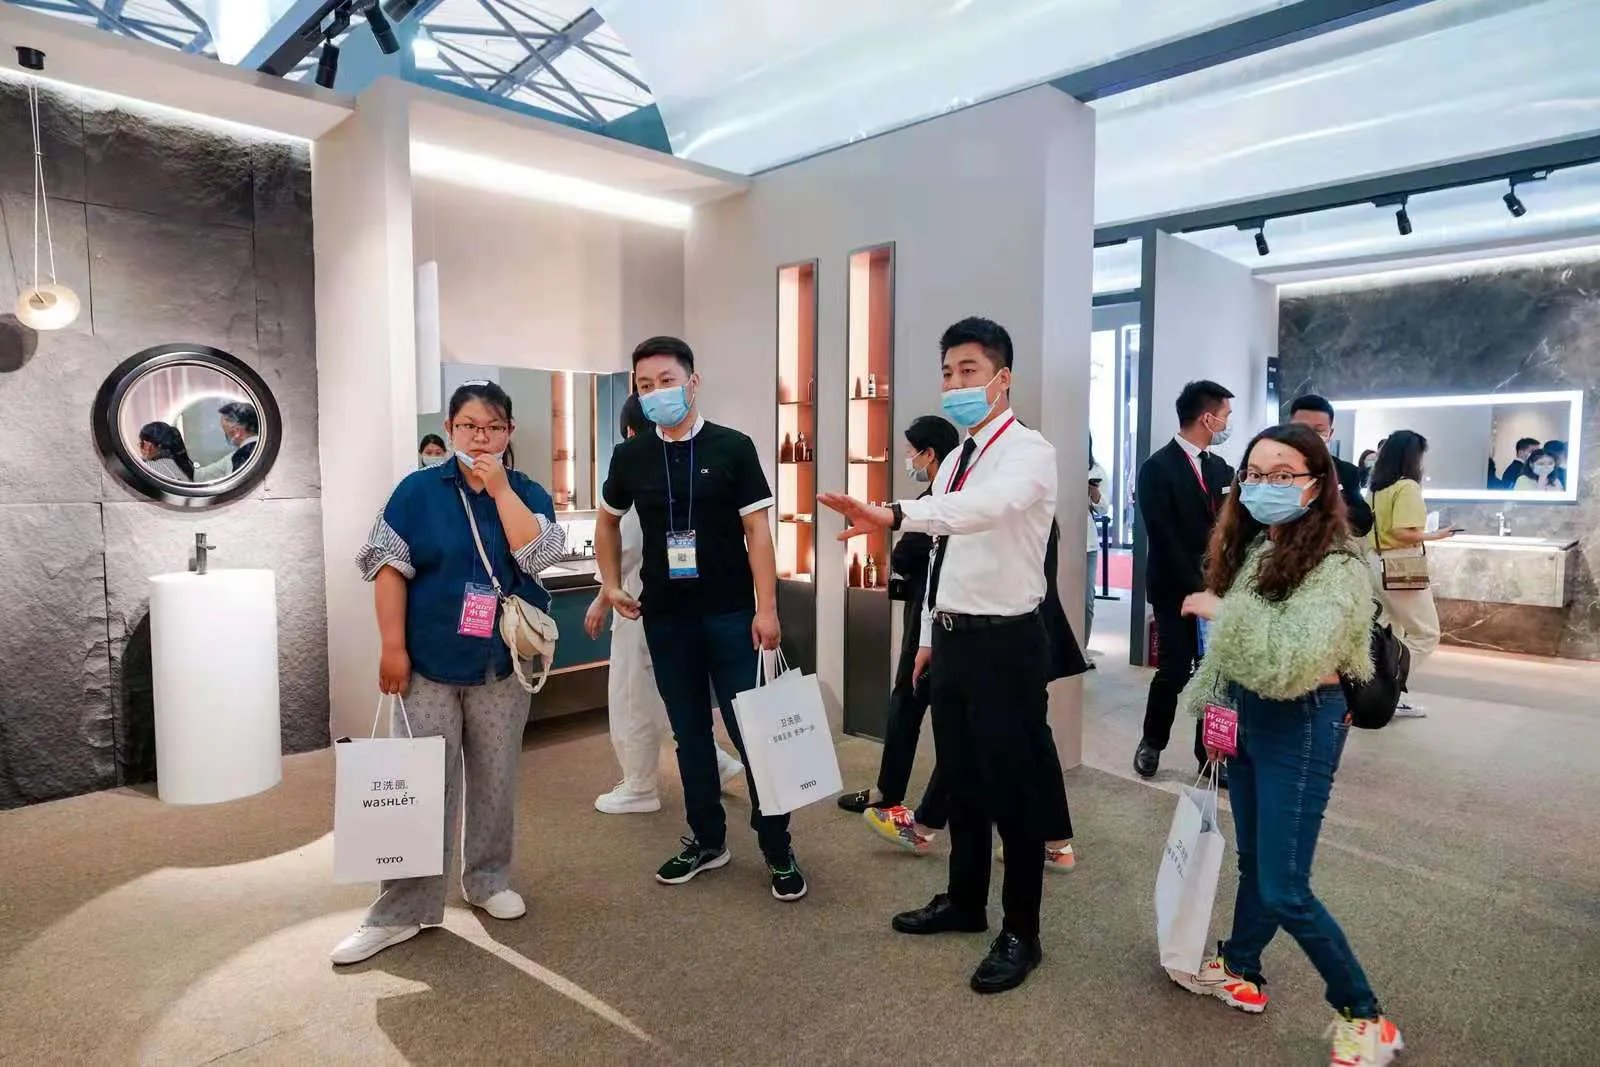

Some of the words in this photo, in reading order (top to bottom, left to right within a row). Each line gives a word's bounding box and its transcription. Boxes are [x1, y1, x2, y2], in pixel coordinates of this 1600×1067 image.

[370, 779, 407, 791] 卫洗丽
[800, 780, 817, 790] TOTO
[376, 856, 403, 864] TOTO
